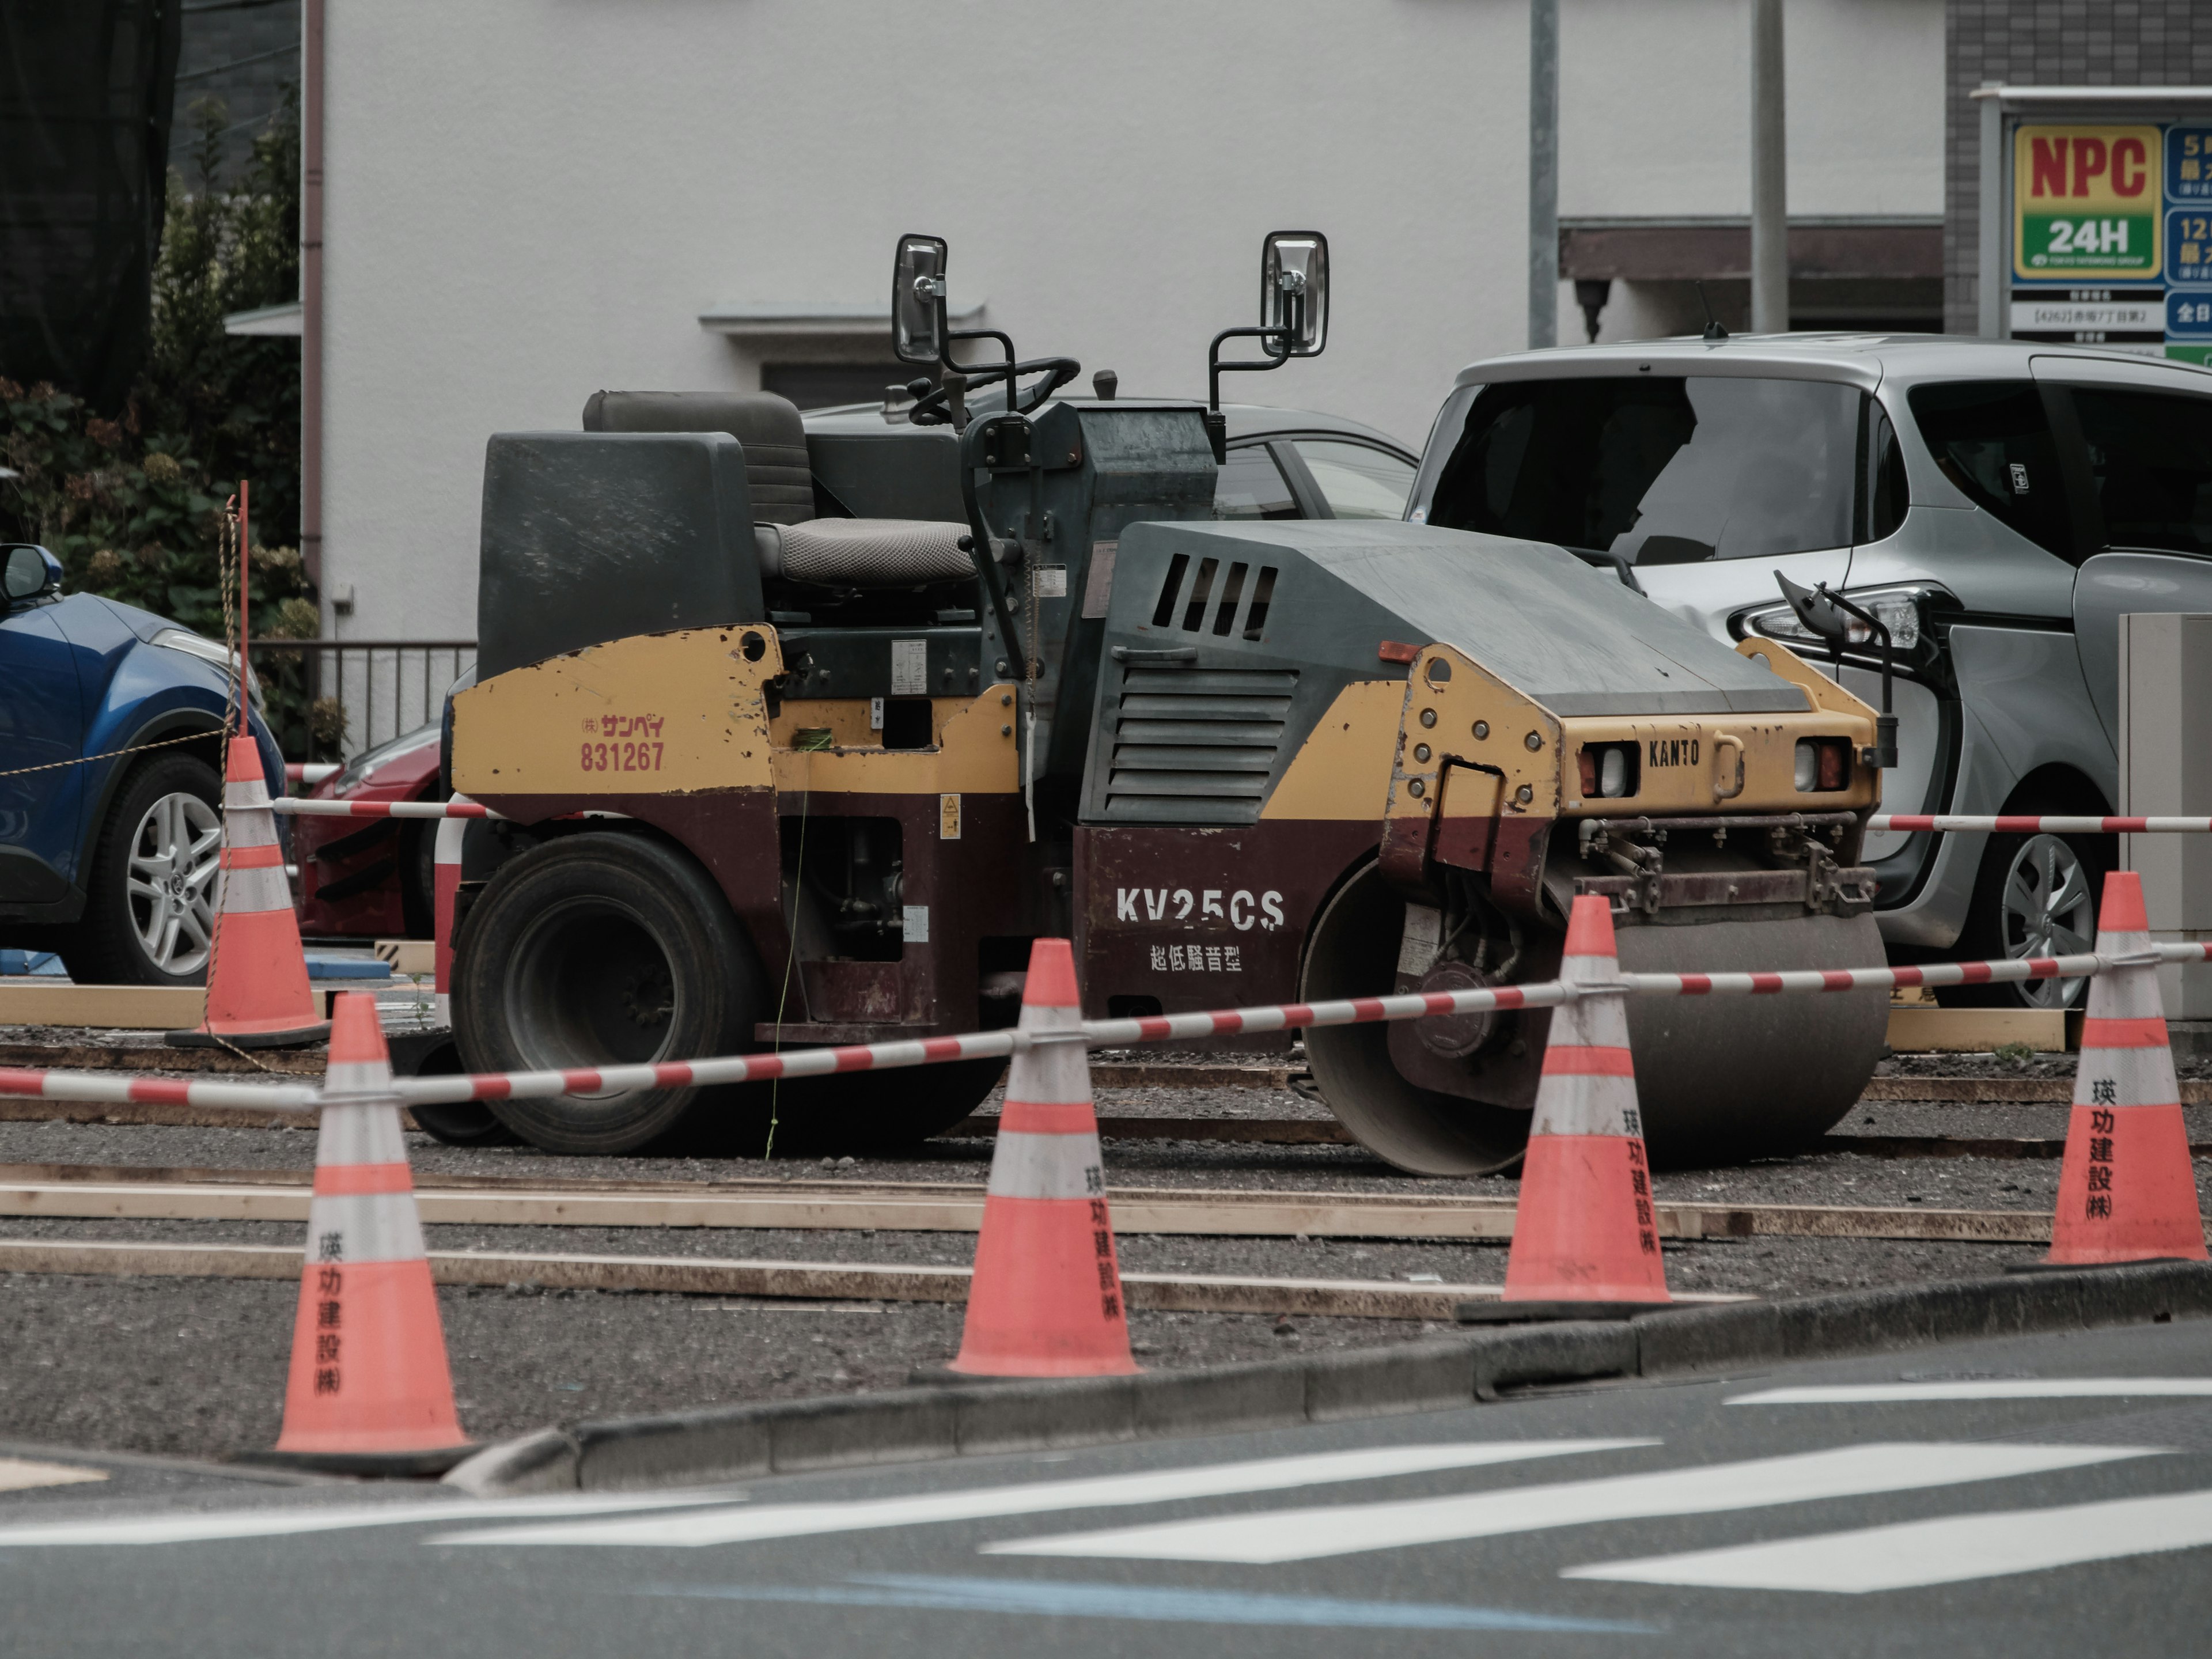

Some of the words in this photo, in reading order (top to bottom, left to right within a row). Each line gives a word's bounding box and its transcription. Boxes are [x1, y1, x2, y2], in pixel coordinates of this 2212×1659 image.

[2031, 137, 2146, 197] NPC
[2048, 219, 2128, 253] 24H
[2181, 218, 2212, 240] 12
[581, 742, 664, 772] 831267
[1650, 739, 1699, 767] KANTO
[1117, 888, 1285, 931] KV25CS
